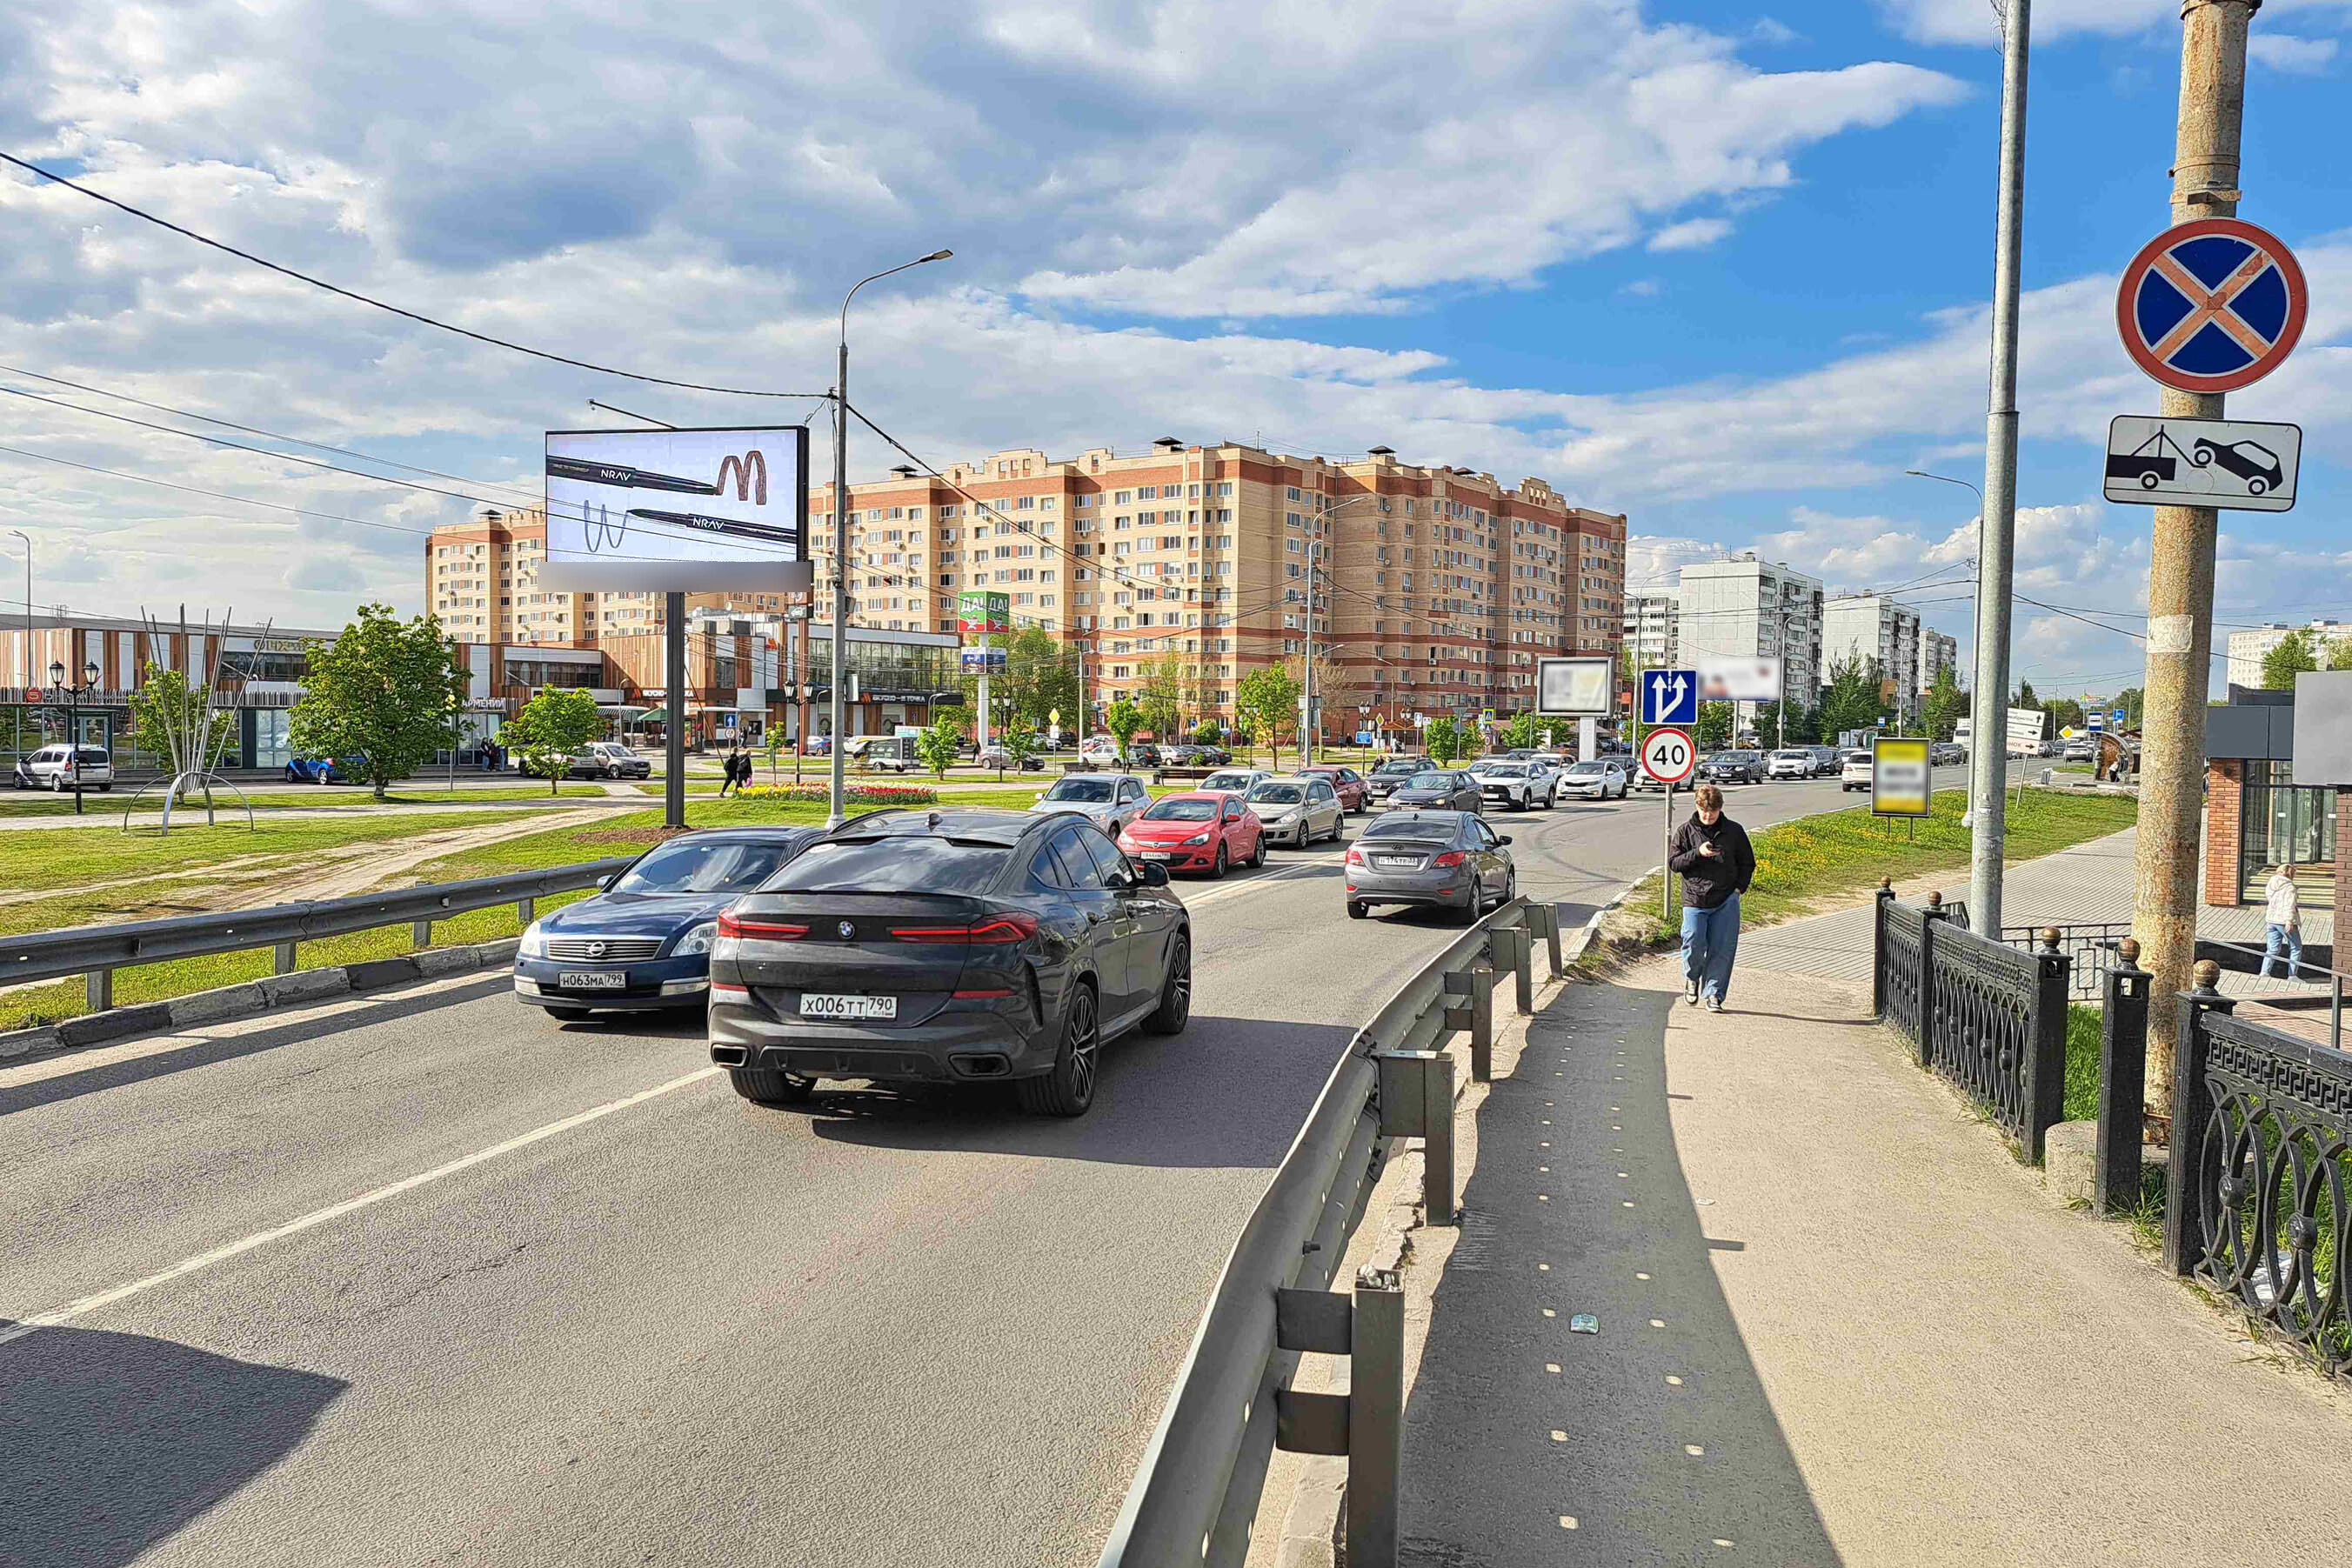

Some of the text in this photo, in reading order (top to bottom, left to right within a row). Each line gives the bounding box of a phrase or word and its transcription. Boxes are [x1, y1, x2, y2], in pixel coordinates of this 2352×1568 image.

[960, 597, 984, 613] ДА!
[988, 597, 1007, 613] ДА!
[1653, 745, 1685, 765] 40
